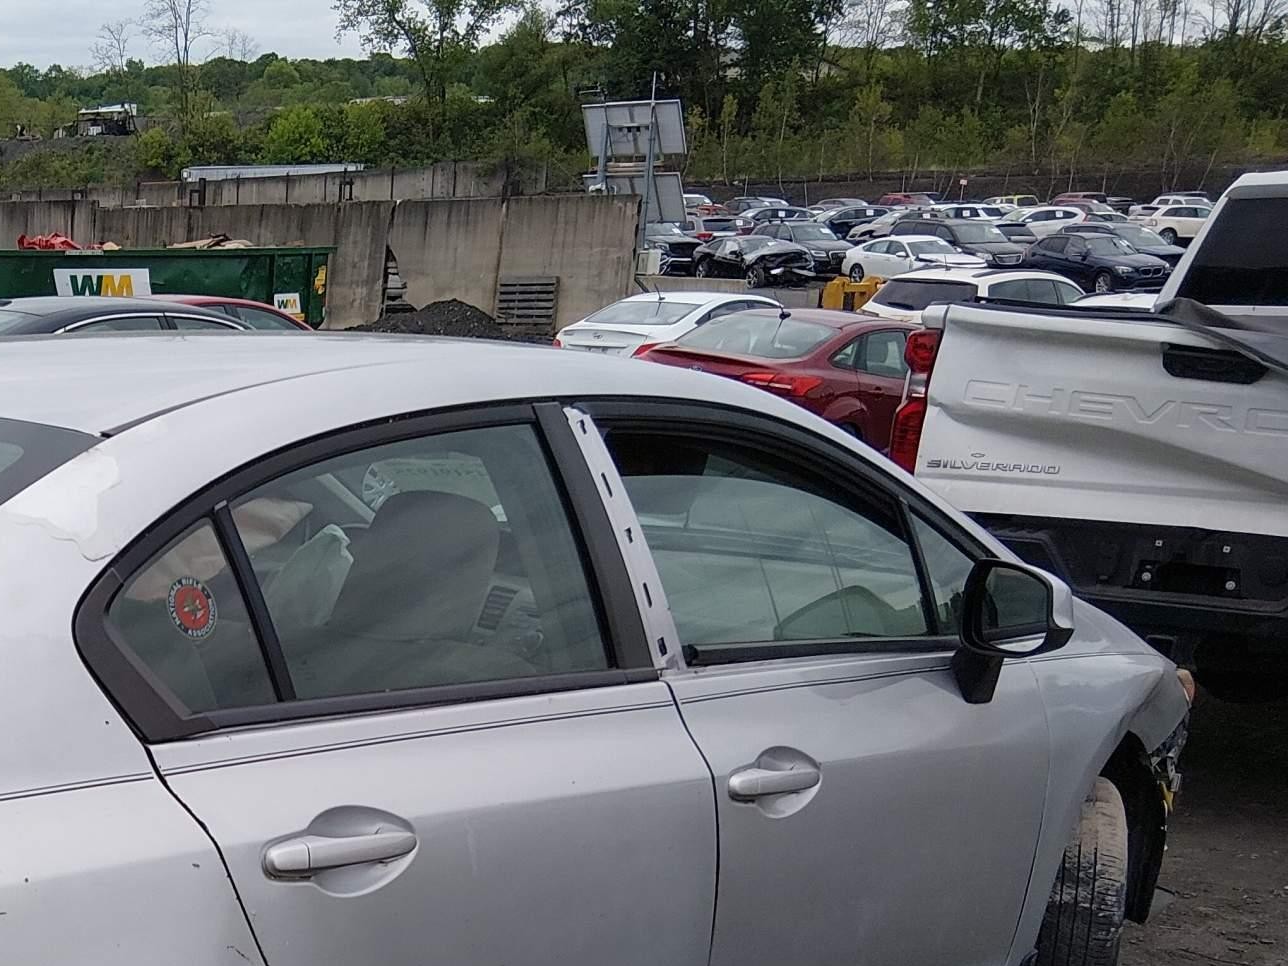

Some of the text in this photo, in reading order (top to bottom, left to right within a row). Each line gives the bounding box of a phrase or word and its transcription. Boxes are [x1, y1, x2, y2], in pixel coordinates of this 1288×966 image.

[69, 274, 134, 297] WM
[277, 298, 298, 310] WM
[926, 459, 1061, 475] SILVERADO
